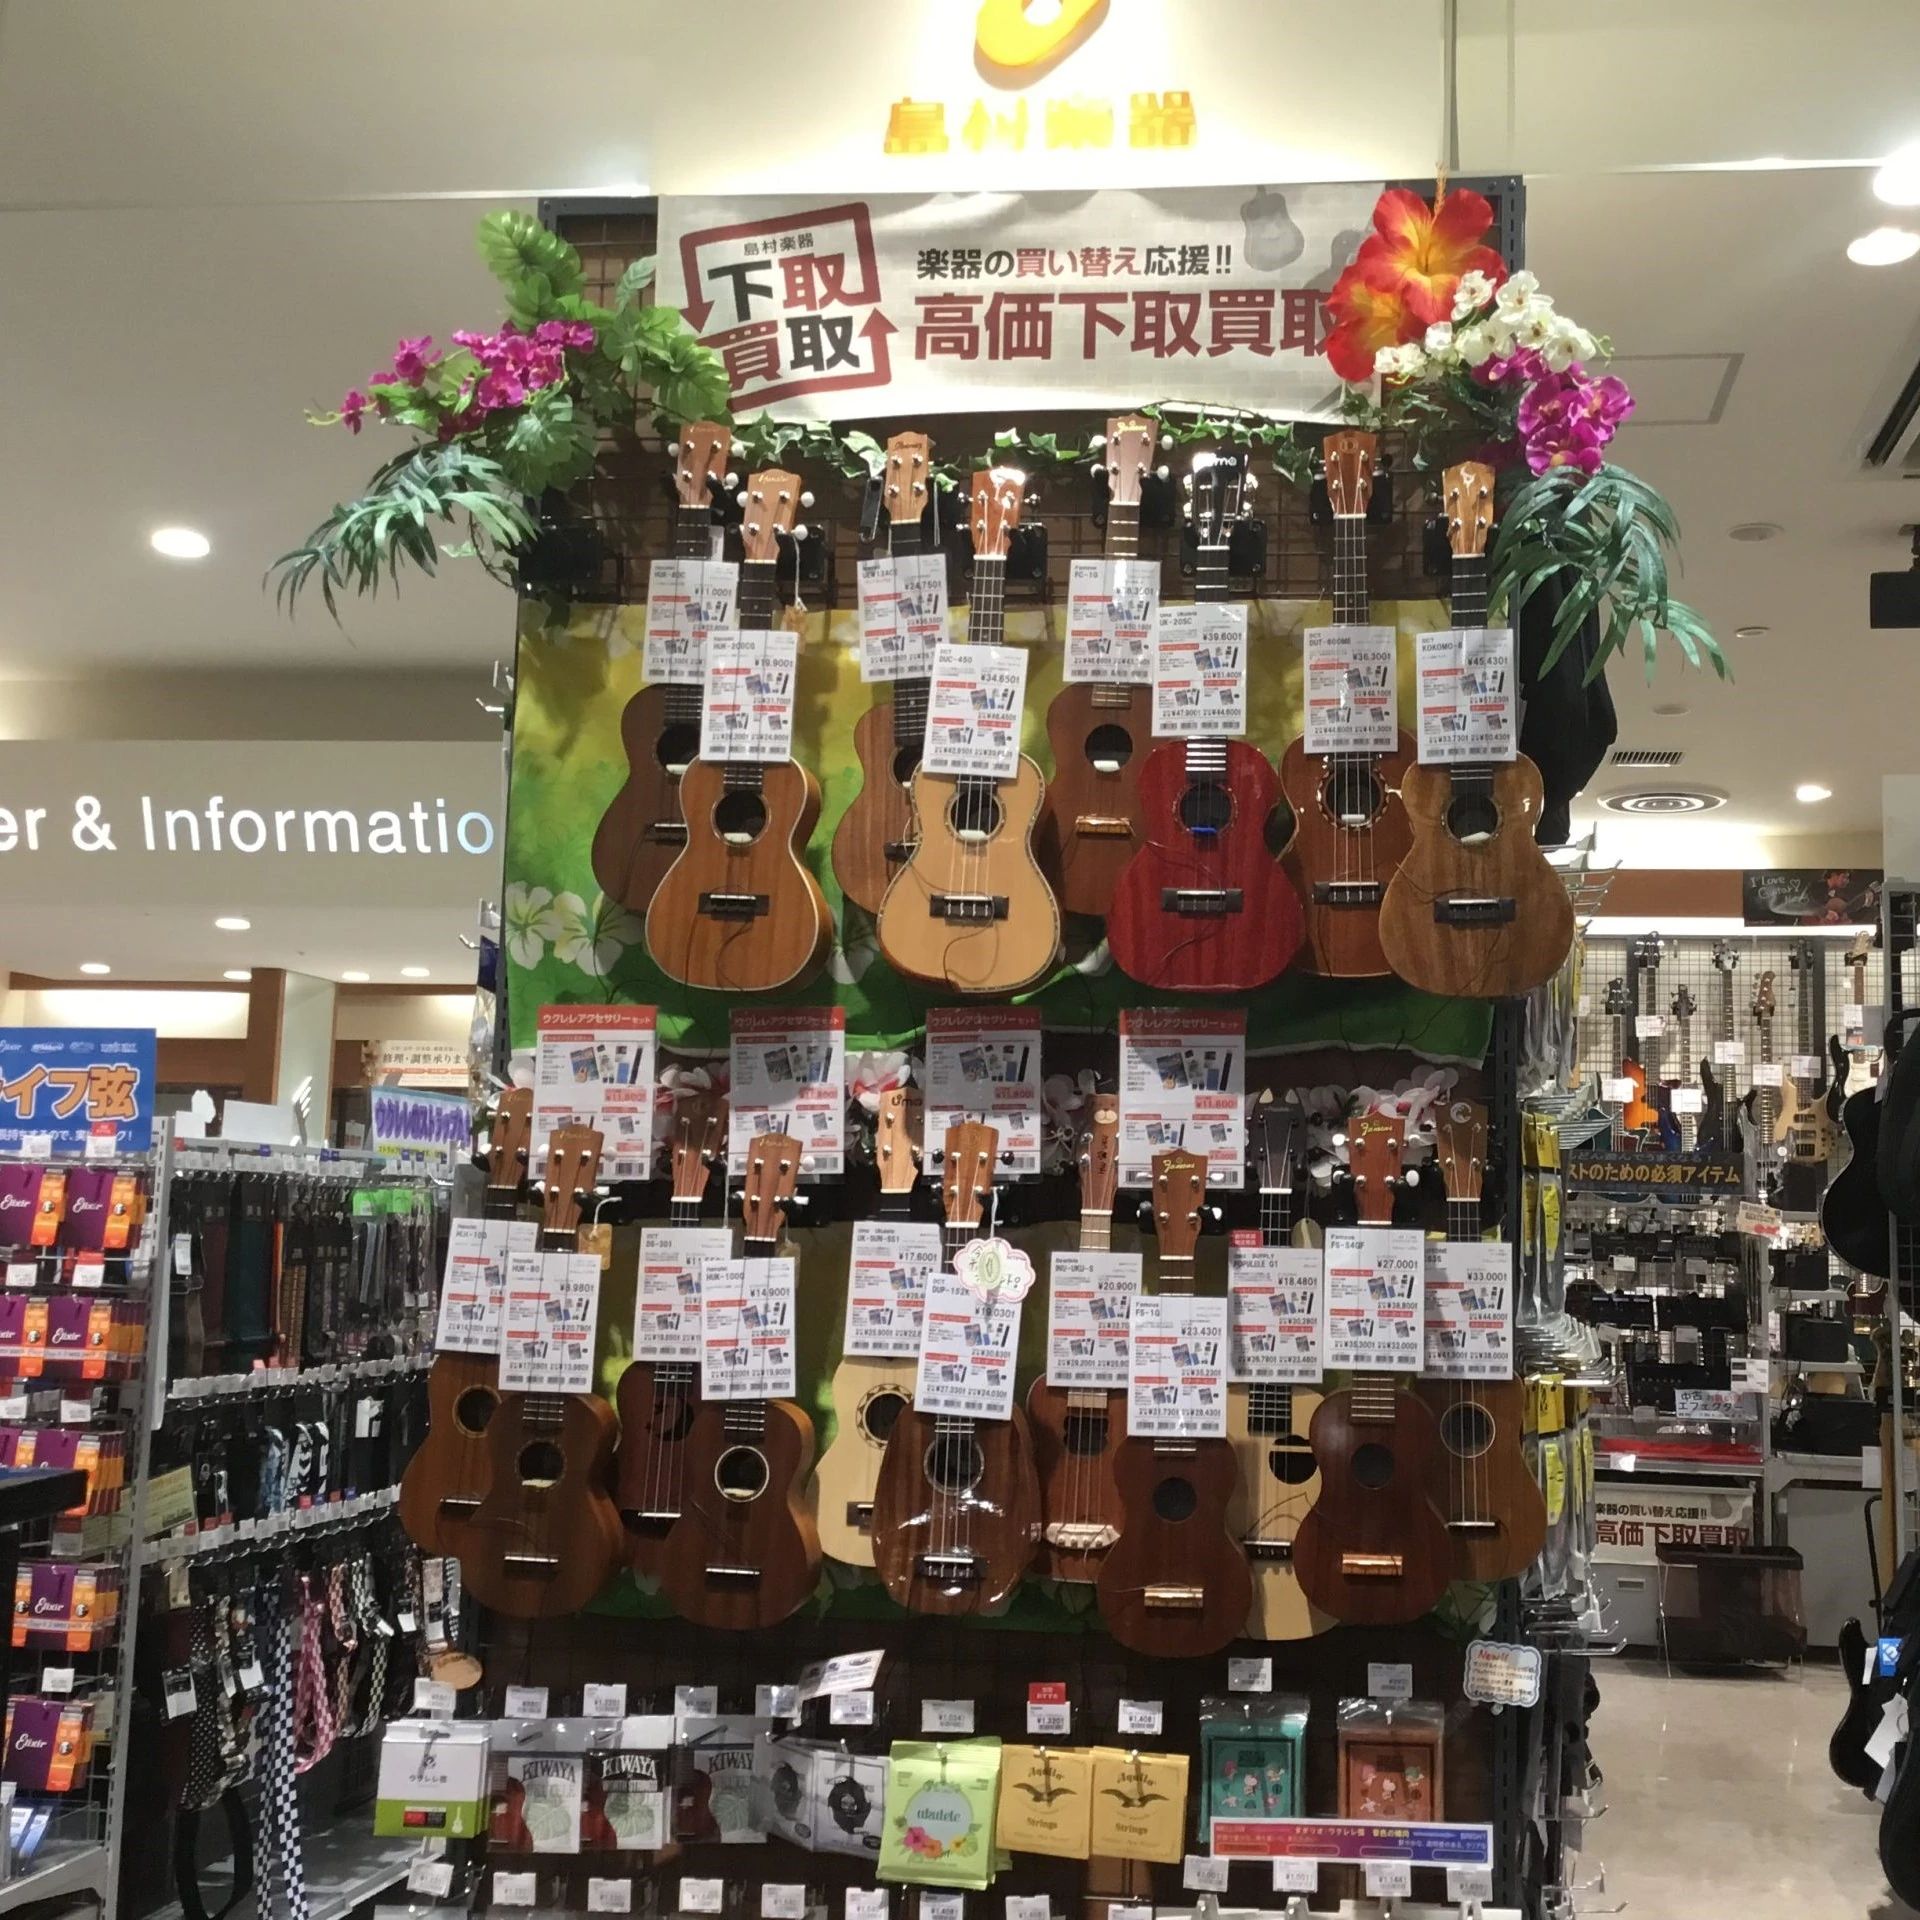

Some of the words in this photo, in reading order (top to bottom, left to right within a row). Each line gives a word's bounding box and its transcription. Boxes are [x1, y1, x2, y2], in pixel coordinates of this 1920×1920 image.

[743, 232, 814, 257] 島村楽器
[707, 252, 854, 322] 下取
[915, 290, 1335, 361] 高価下取買取
[696, 314, 860, 392] 買取
[72, 795, 117, 851] &
[384, 1053, 469, 1064] 修理・調整承りま
[0, 1063, 140, 1121] イフ弦
[35, 1598, 64, 1614] Elixir
[15, 1734, 48, 1751] Elixir
[522, 1759, 576, 1783] KIWAYA
[602, 1755, 657, 1778] KIWAYA
[709, 1752, 754, 1772] KIWAY
